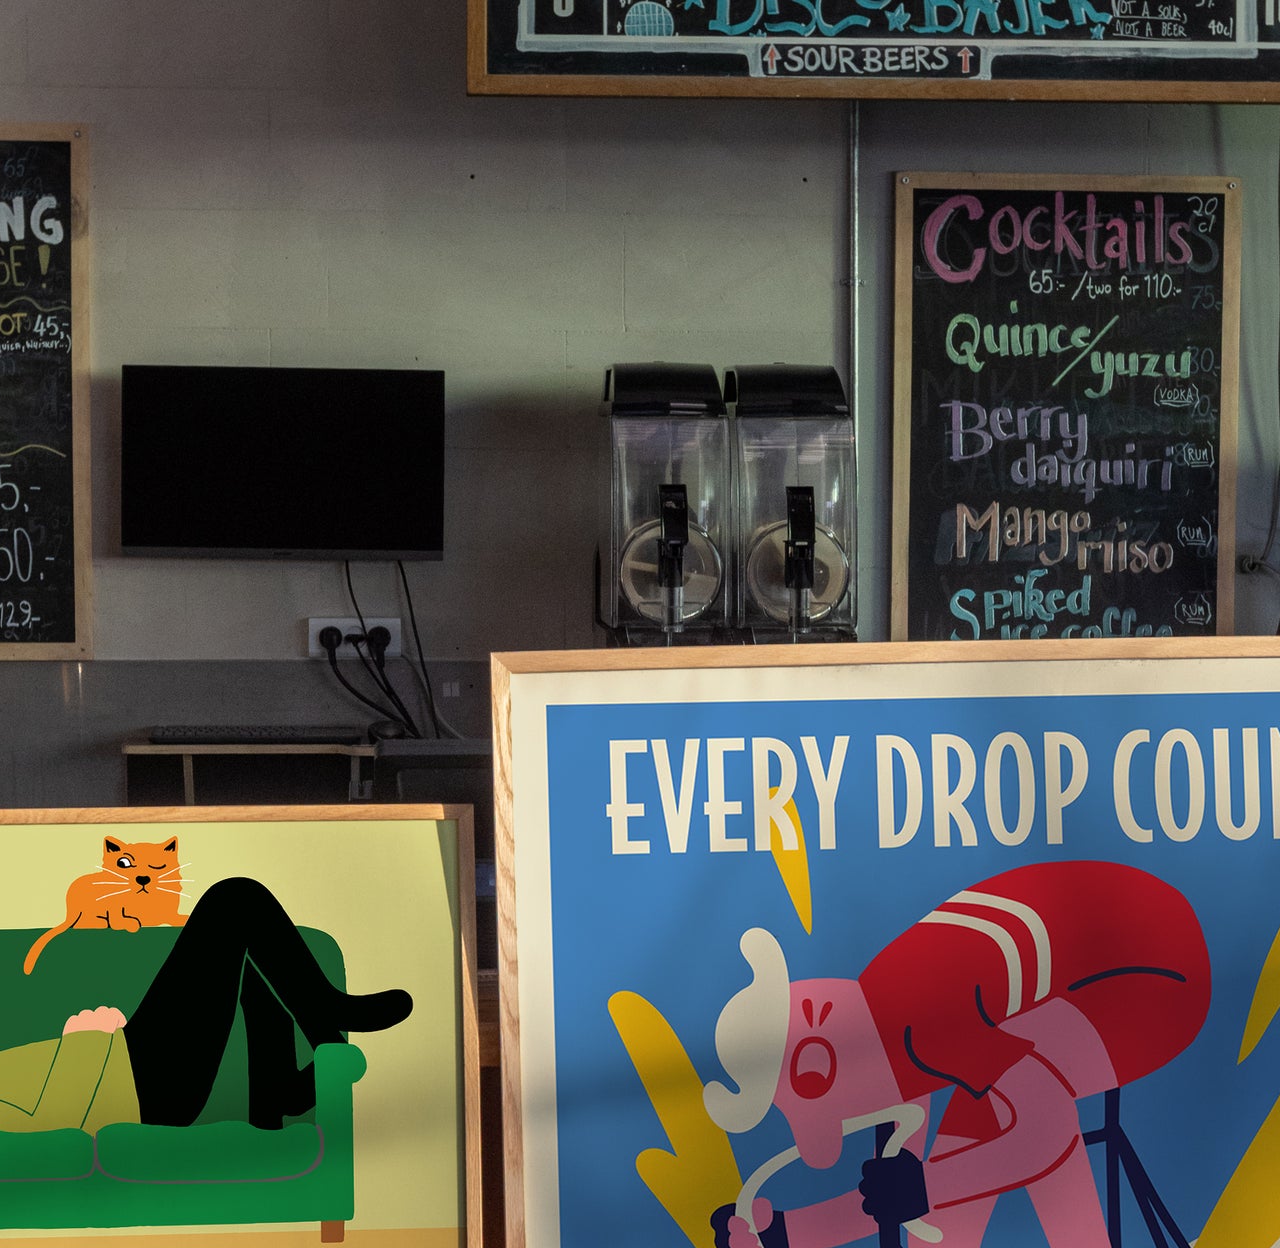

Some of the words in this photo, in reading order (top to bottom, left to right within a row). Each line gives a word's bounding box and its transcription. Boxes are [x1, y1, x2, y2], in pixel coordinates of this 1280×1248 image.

[1115, 20, 1139, 36] NOT
[1145, 22, 1152, 37] A
[1161, 22, 1187, 38] BEER
[1141, 0, 1150, 17] A
[782, 46, 861, 74] SOUR
[862, 45, 948, 74] BEERS
[1187, 196, 1218, 216] 20
[924, 191, 1193, 283] Cocktails
[1119, 278, 1140, 300] for
[1085, 350, 1192, 398] yuzu
[939, 400, 1088, 462] Berry
[1011, 440, 1174, 504] daiquiri
[956, 501, 1091, 566] Mango
[1077, 520, 1174, 574] miso
[950, 568, 1092, 640] Spiked
[606, 734, 850, 855] EVERY
[876, 731, 1090, 849] DROP
